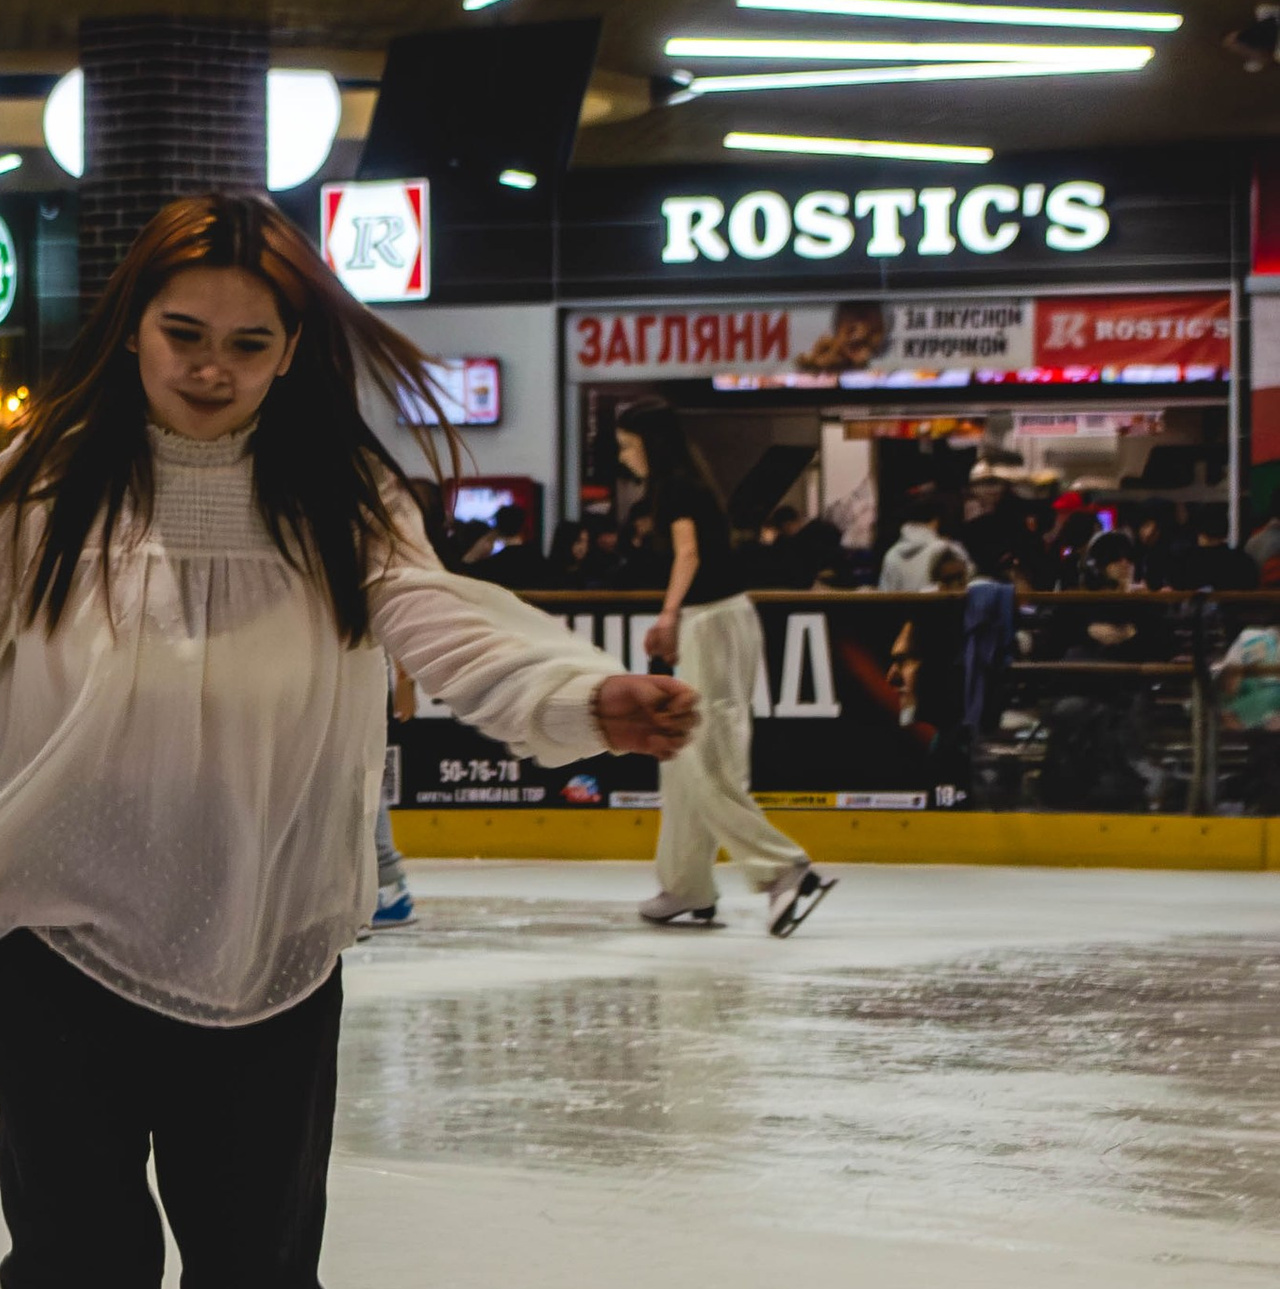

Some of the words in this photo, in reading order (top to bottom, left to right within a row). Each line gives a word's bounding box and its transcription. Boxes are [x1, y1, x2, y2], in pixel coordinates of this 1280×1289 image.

[345, 216, 405, 270] R
[661, 180, 1111, 263] ROSTIC'S
[577, 311, 789, 367] ЗАГЛЯНИ
[1095, 316, 1231, 343] ROSTIC'S
